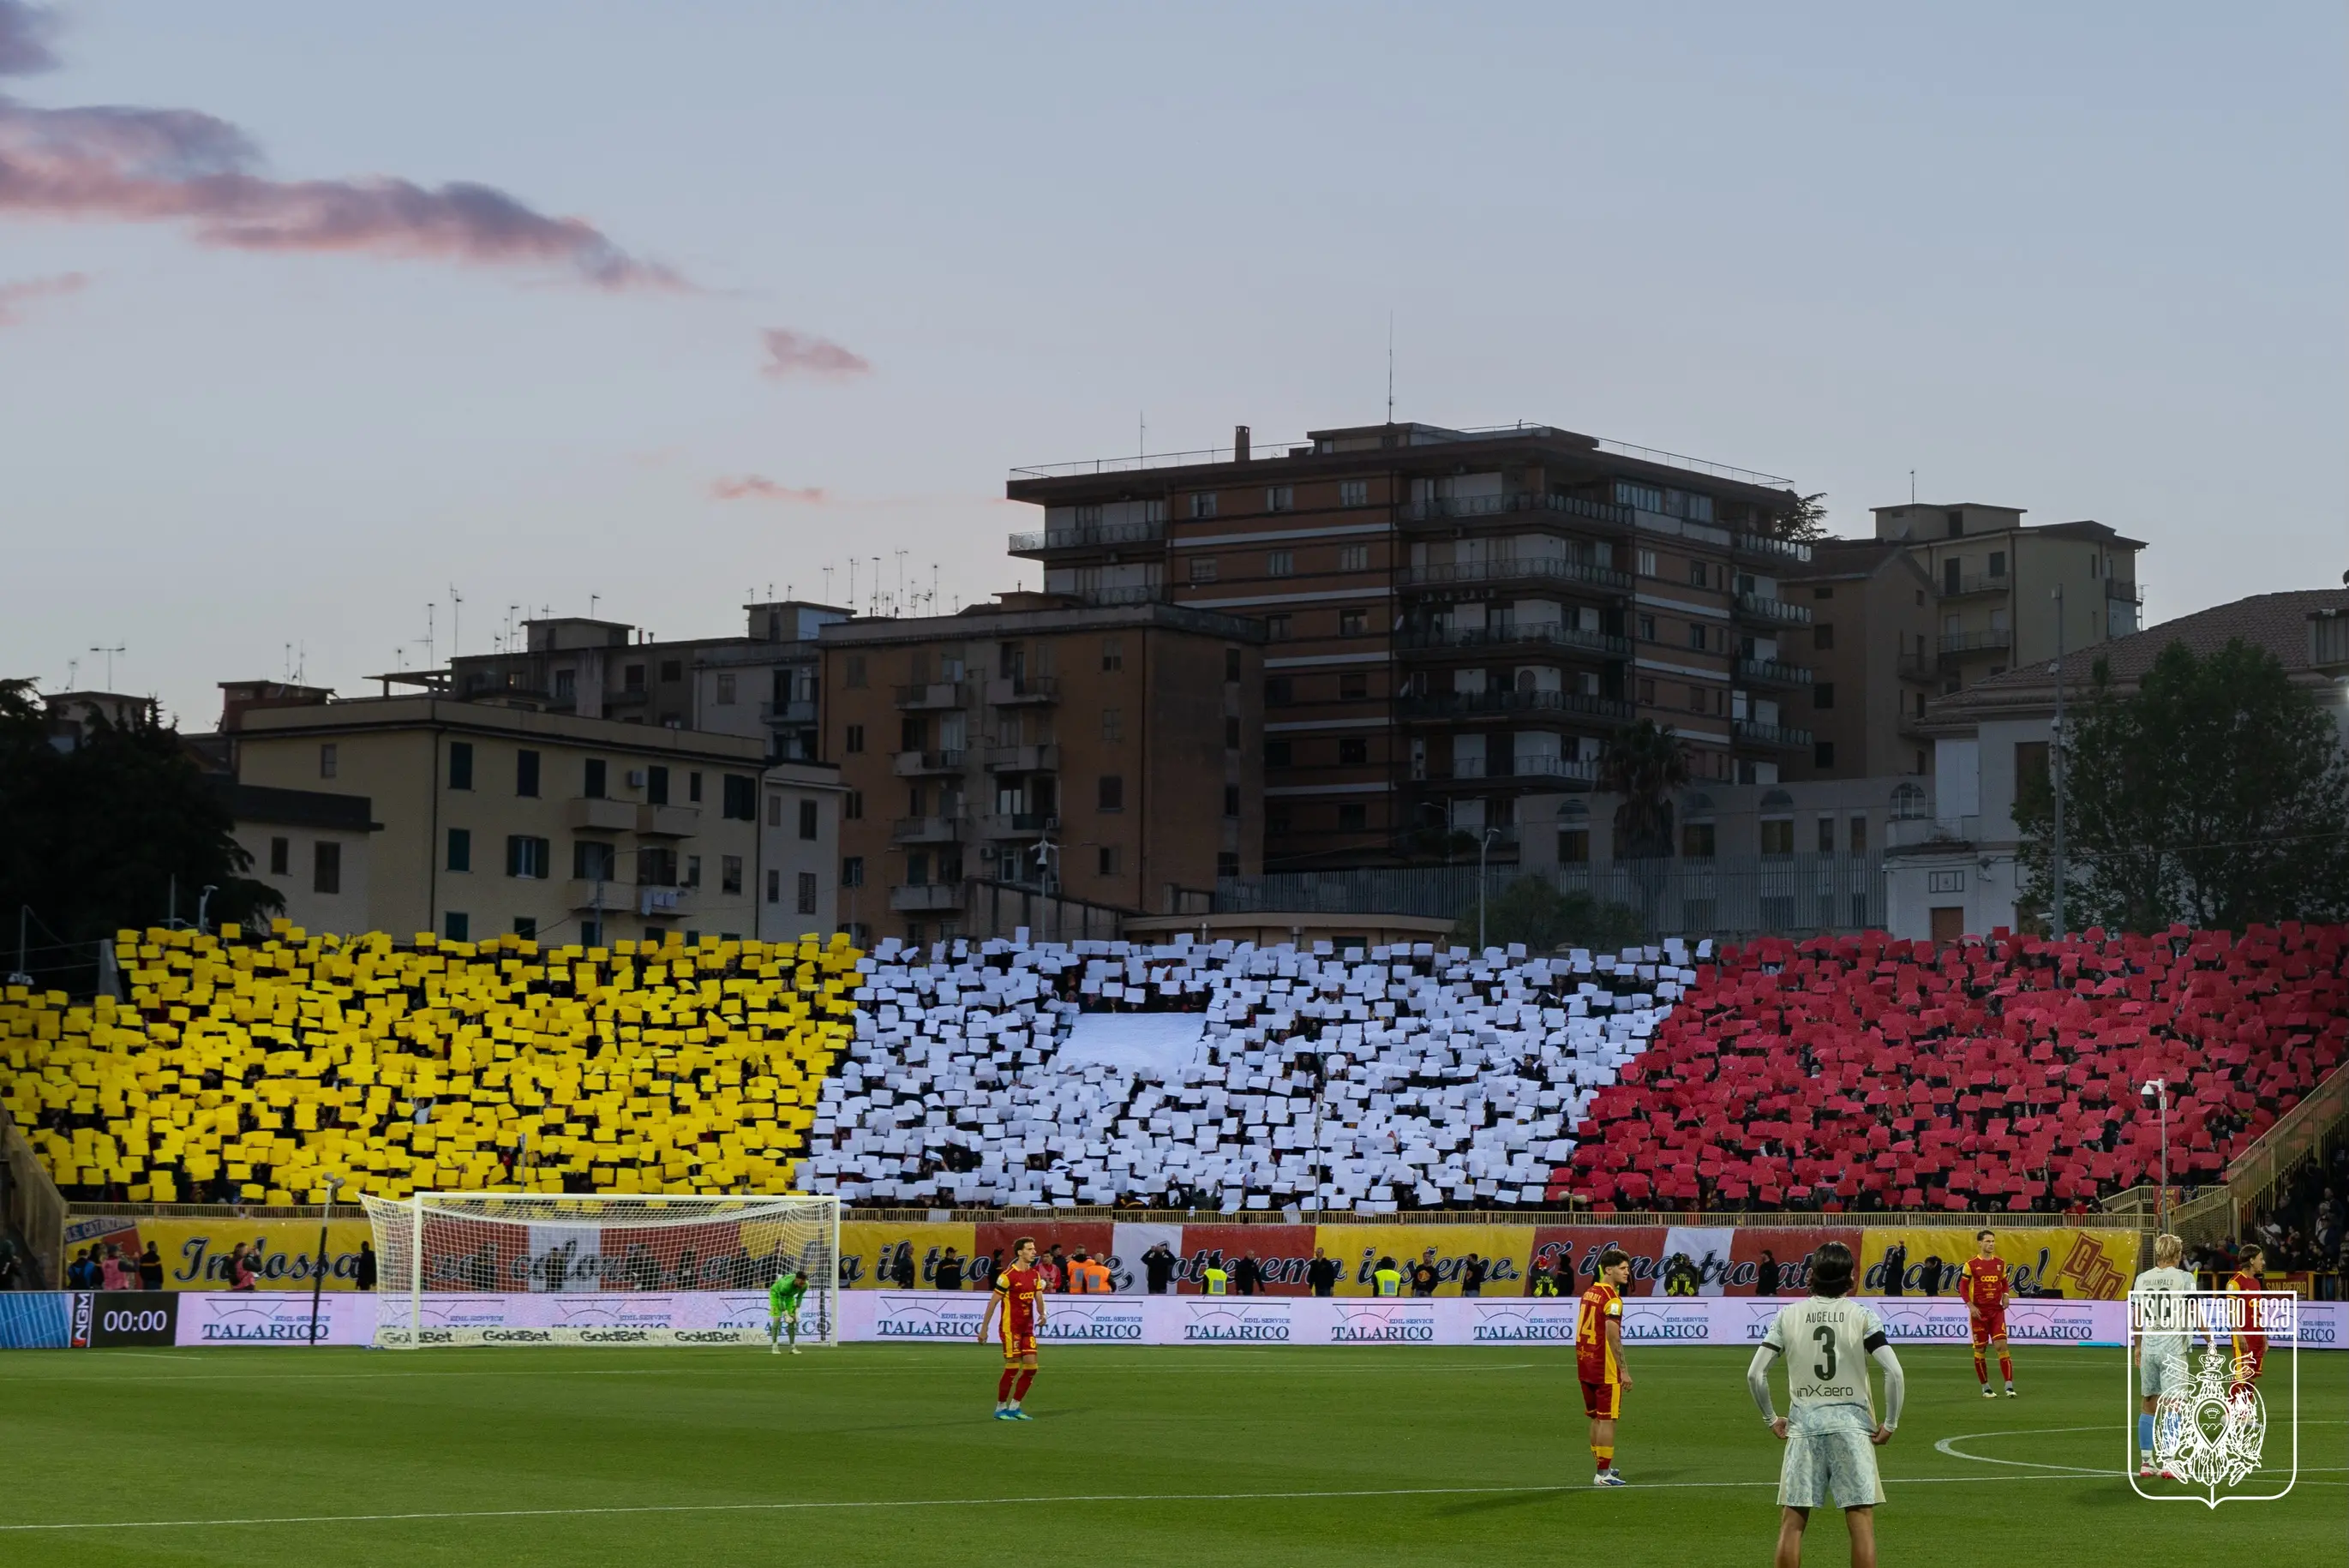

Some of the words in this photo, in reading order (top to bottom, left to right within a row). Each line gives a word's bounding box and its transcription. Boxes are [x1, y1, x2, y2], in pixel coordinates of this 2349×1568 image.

[1980, 1274, 1998, 1283] coop
[104, 1310, 167, 1331] 00:00
[1576, 1303, 1597, 1344] 14
[1806, 1312, 1844, 1323] AUGELLO
[1034, 1324, 1142, 1338] TALARICO
[1184, 1326, 1289, 1339] TALARICO
[1332, 1326, 1433, 1340] TALARICO
[1474, 1326, 1573, 1339] TALARICO
[2007, 1326, 2092, 1338] TALARICO
[1813, 1325, 1837, 1381] 3
